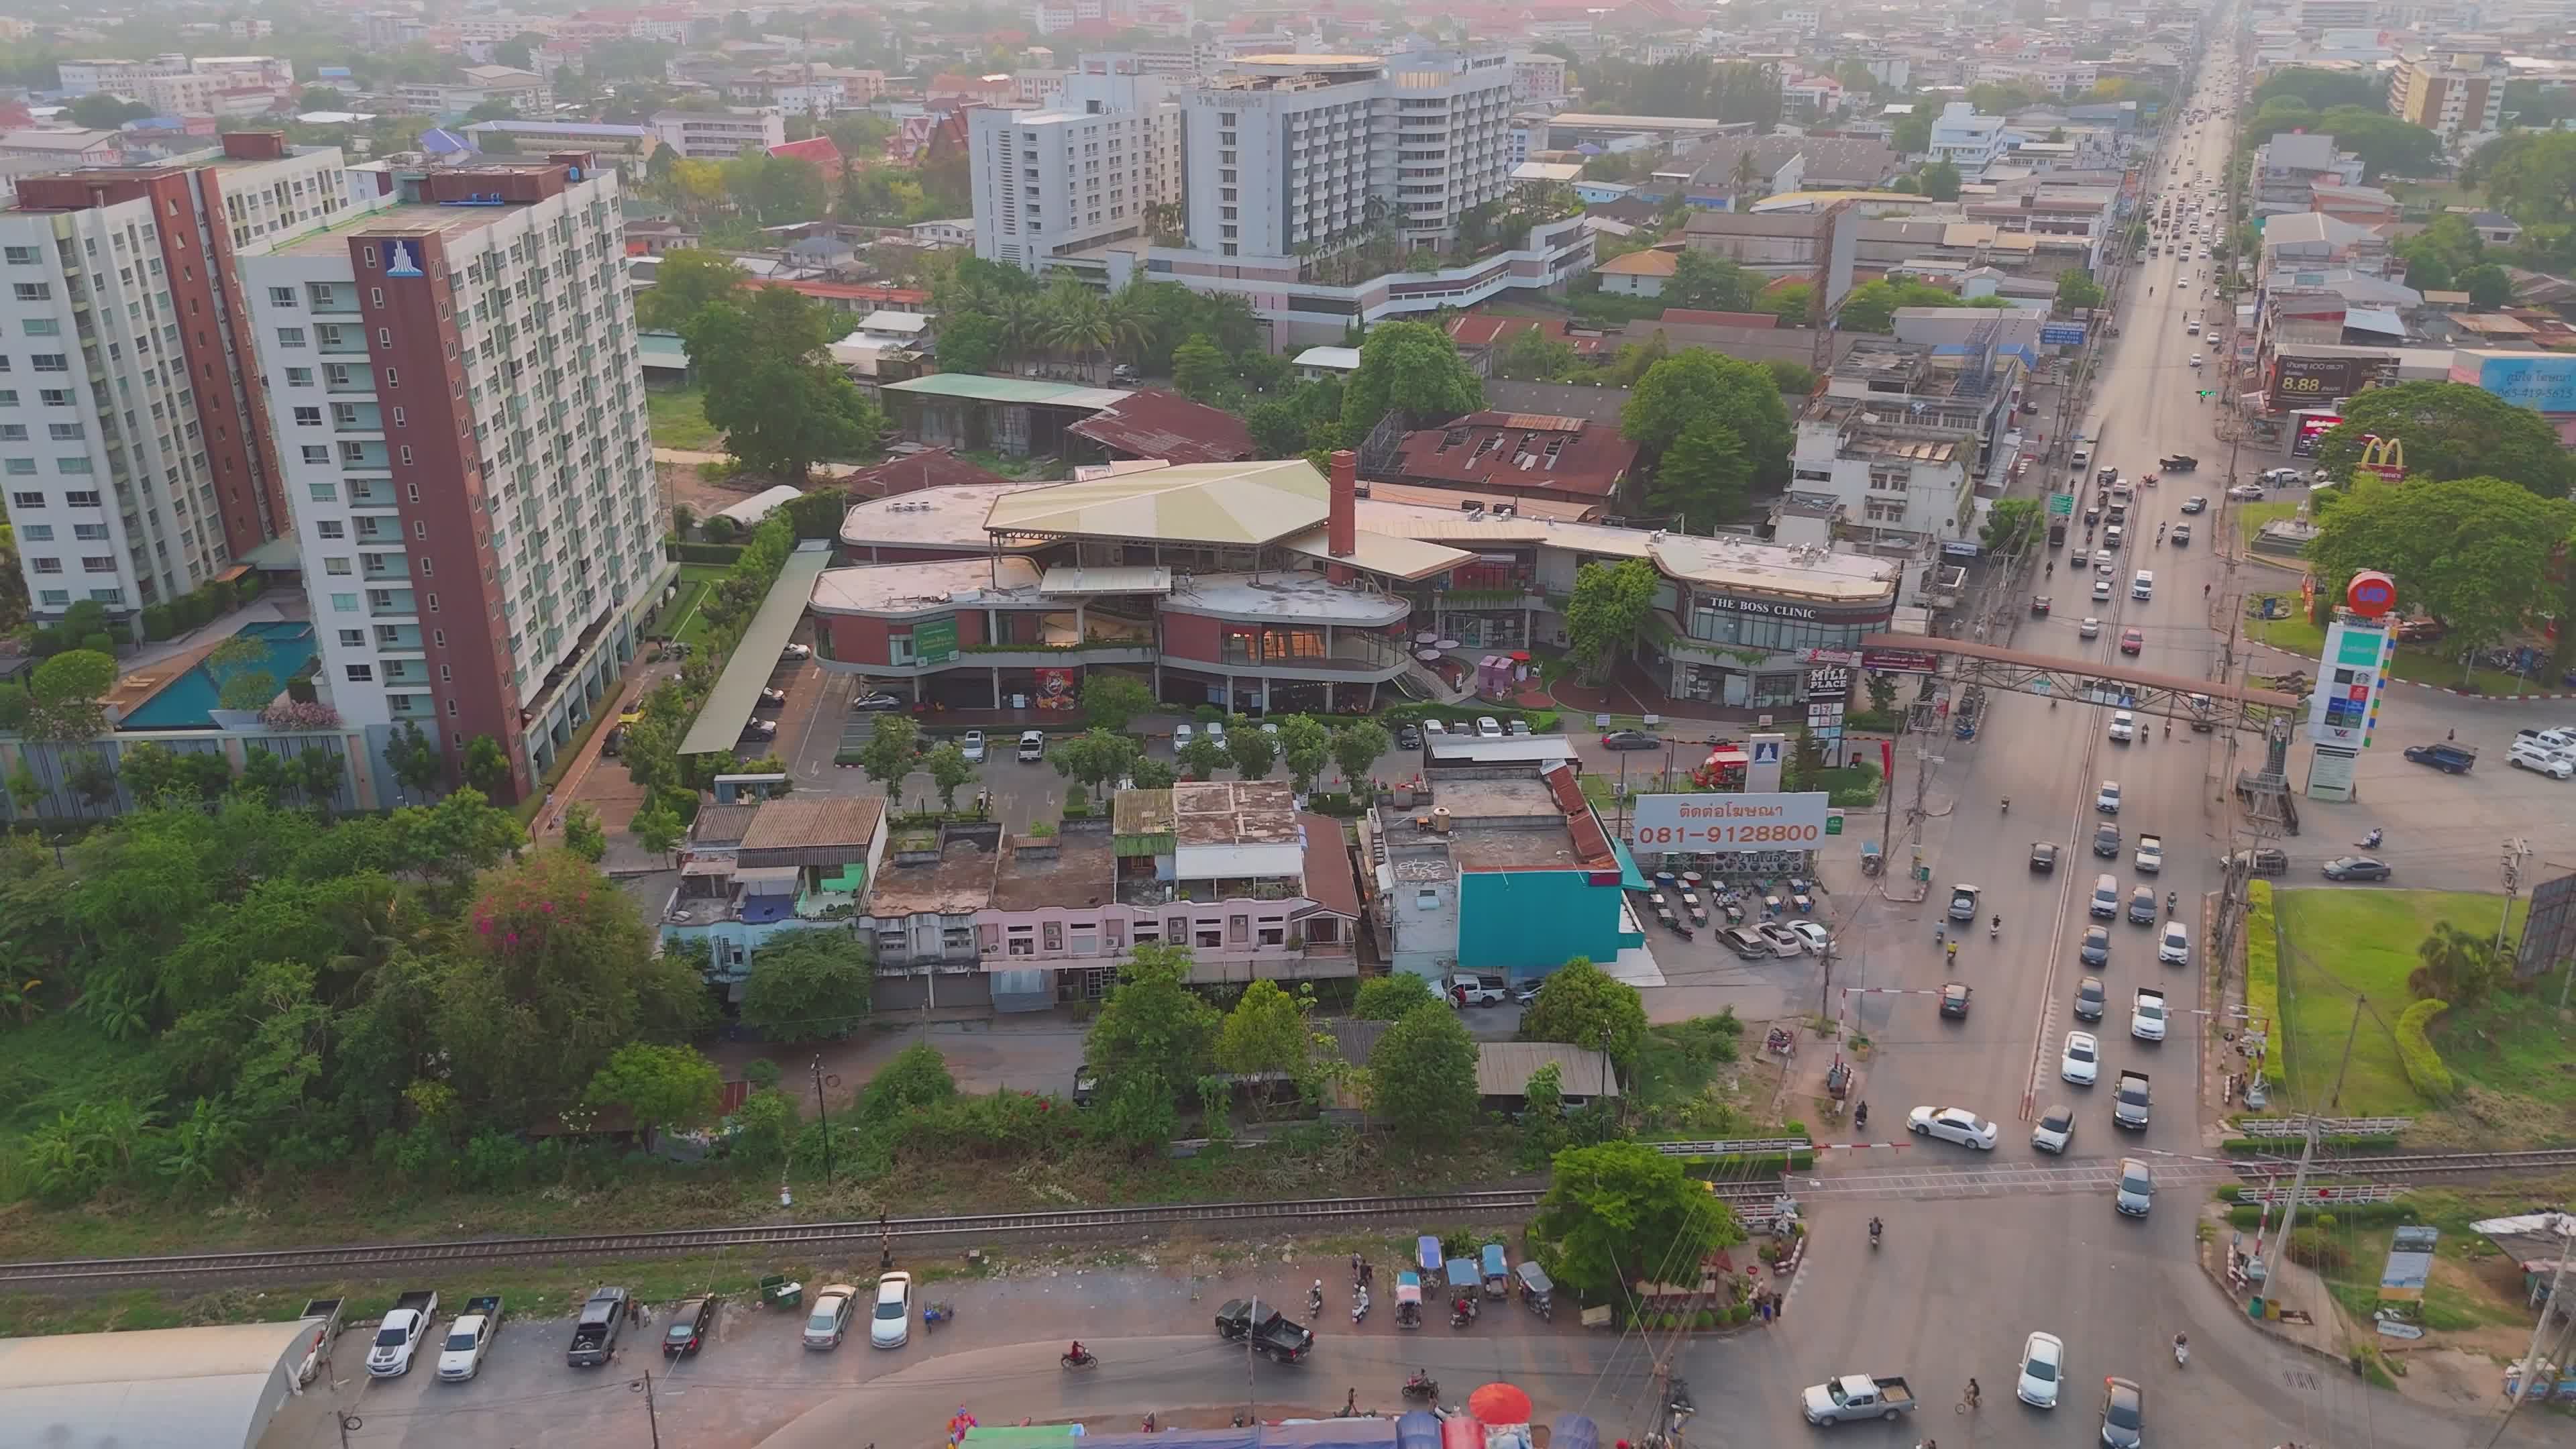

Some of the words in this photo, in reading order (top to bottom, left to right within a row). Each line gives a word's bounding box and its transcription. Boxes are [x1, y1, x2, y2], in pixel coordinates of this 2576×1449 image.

[2309, 362, 2325, 370] 100
[2282, 376, 2319, 392] 8.88
[1711, 597, 1735, 609] THE
[1739, 600, 1770, 613] BOSS
[1774, 606, 1817, 619] CLINIC
[1810, 680, 1847, 689] PLACE
[1679, 801, 1783, 818] ติดต่อโฆษณา
[1639, 824, 1818, 844] 081-9128800
